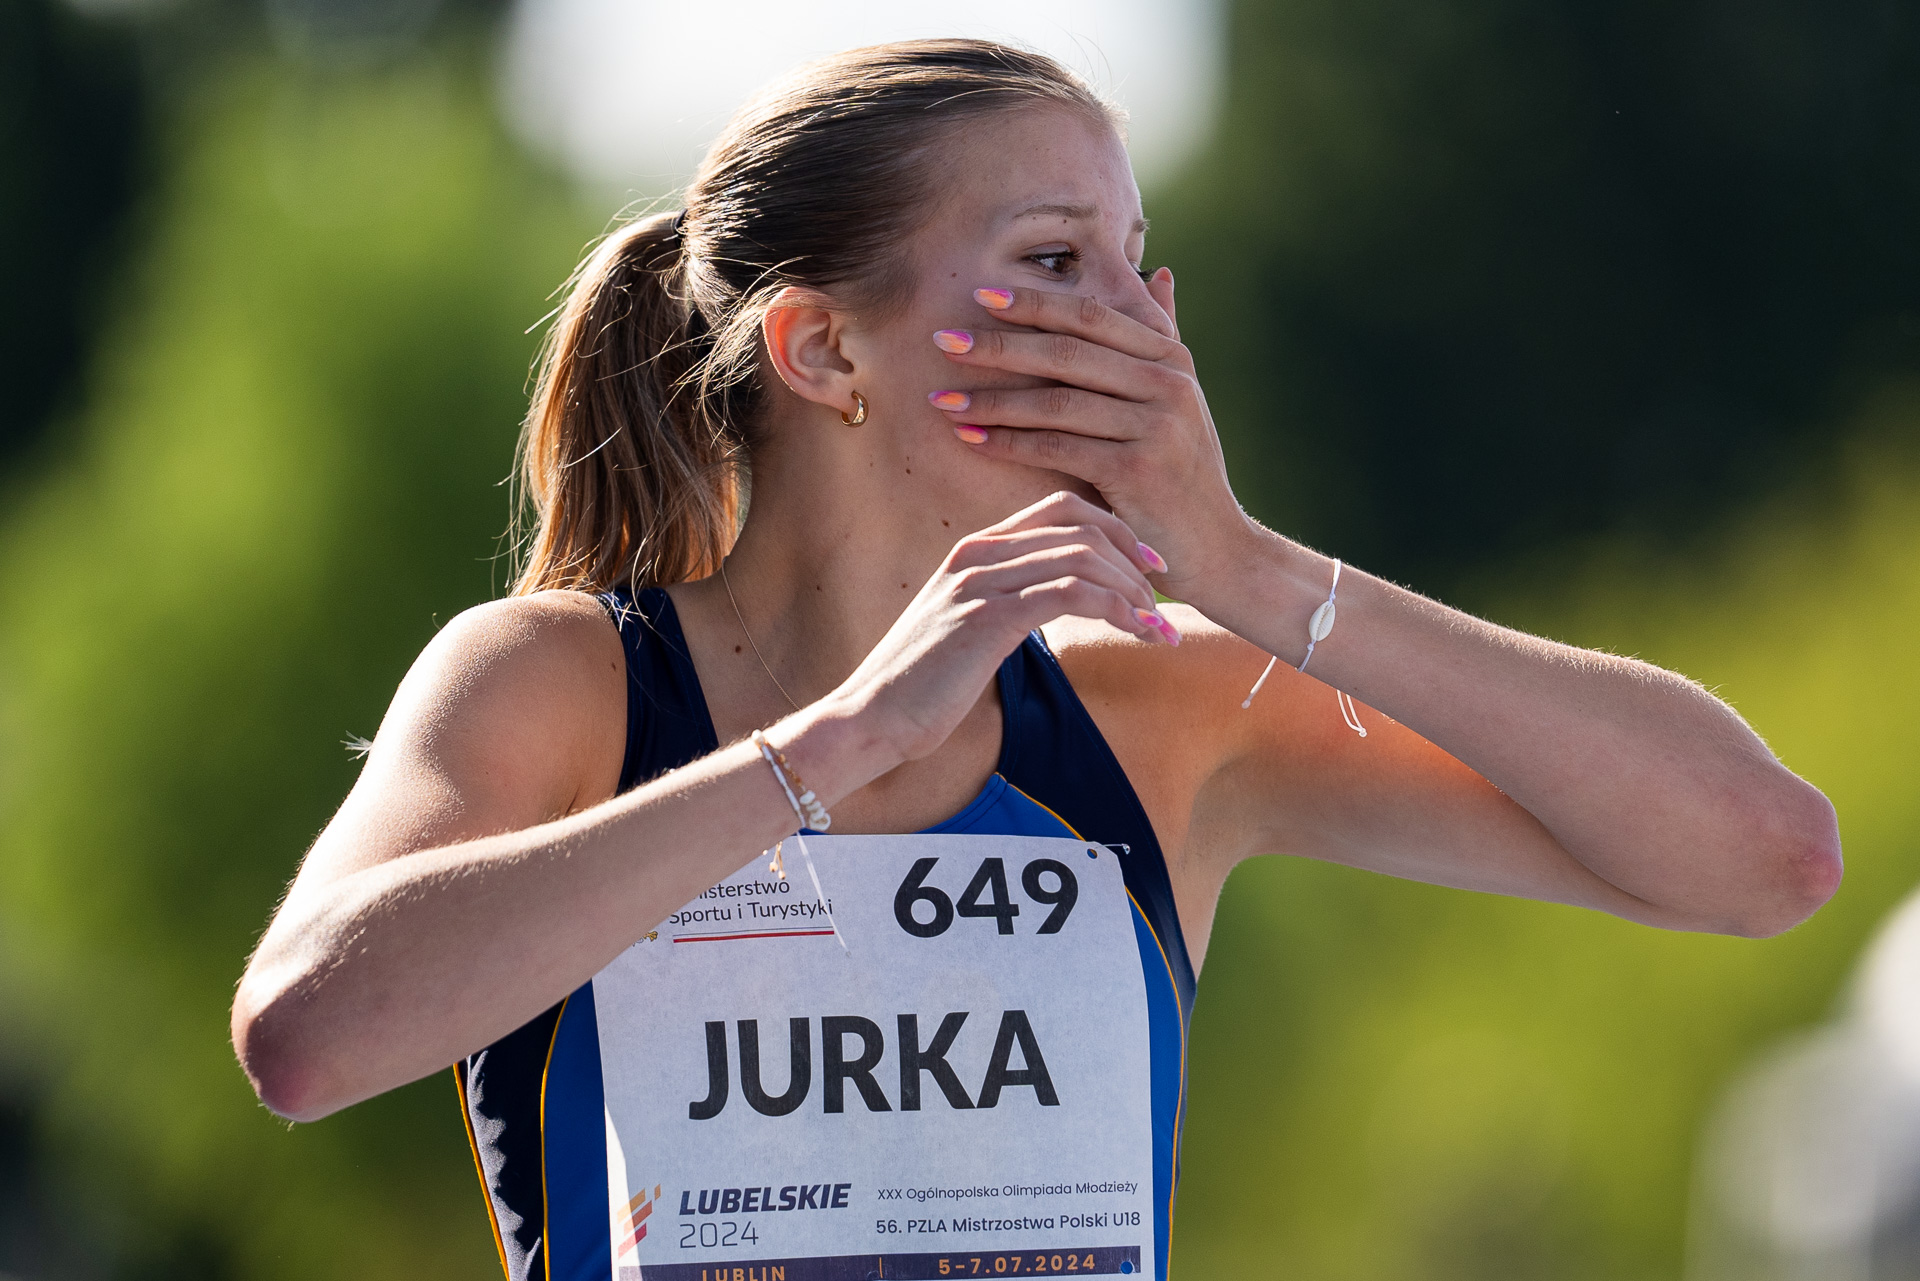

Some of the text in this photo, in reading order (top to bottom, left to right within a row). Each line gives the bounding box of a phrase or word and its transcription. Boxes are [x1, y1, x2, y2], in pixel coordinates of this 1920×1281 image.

[693, 880, 790, 900] isterstwo
[893, 857, 1079, 938] 649
[669, 899, 833, 926] Sportu i Turystyki
[688, 1009, 1060, 1120] JURKA
[679, 1183, 852, 1216] LUBELSKIE
[878, 1180, 1138, 1202] XXX Ogólnopolska Olimpiada Młodzieży
[679, 1221, 760, 1249] 2024
[876, 1211, 1141, 1234] 56. PZLA Mistrzostwa Polski U18
